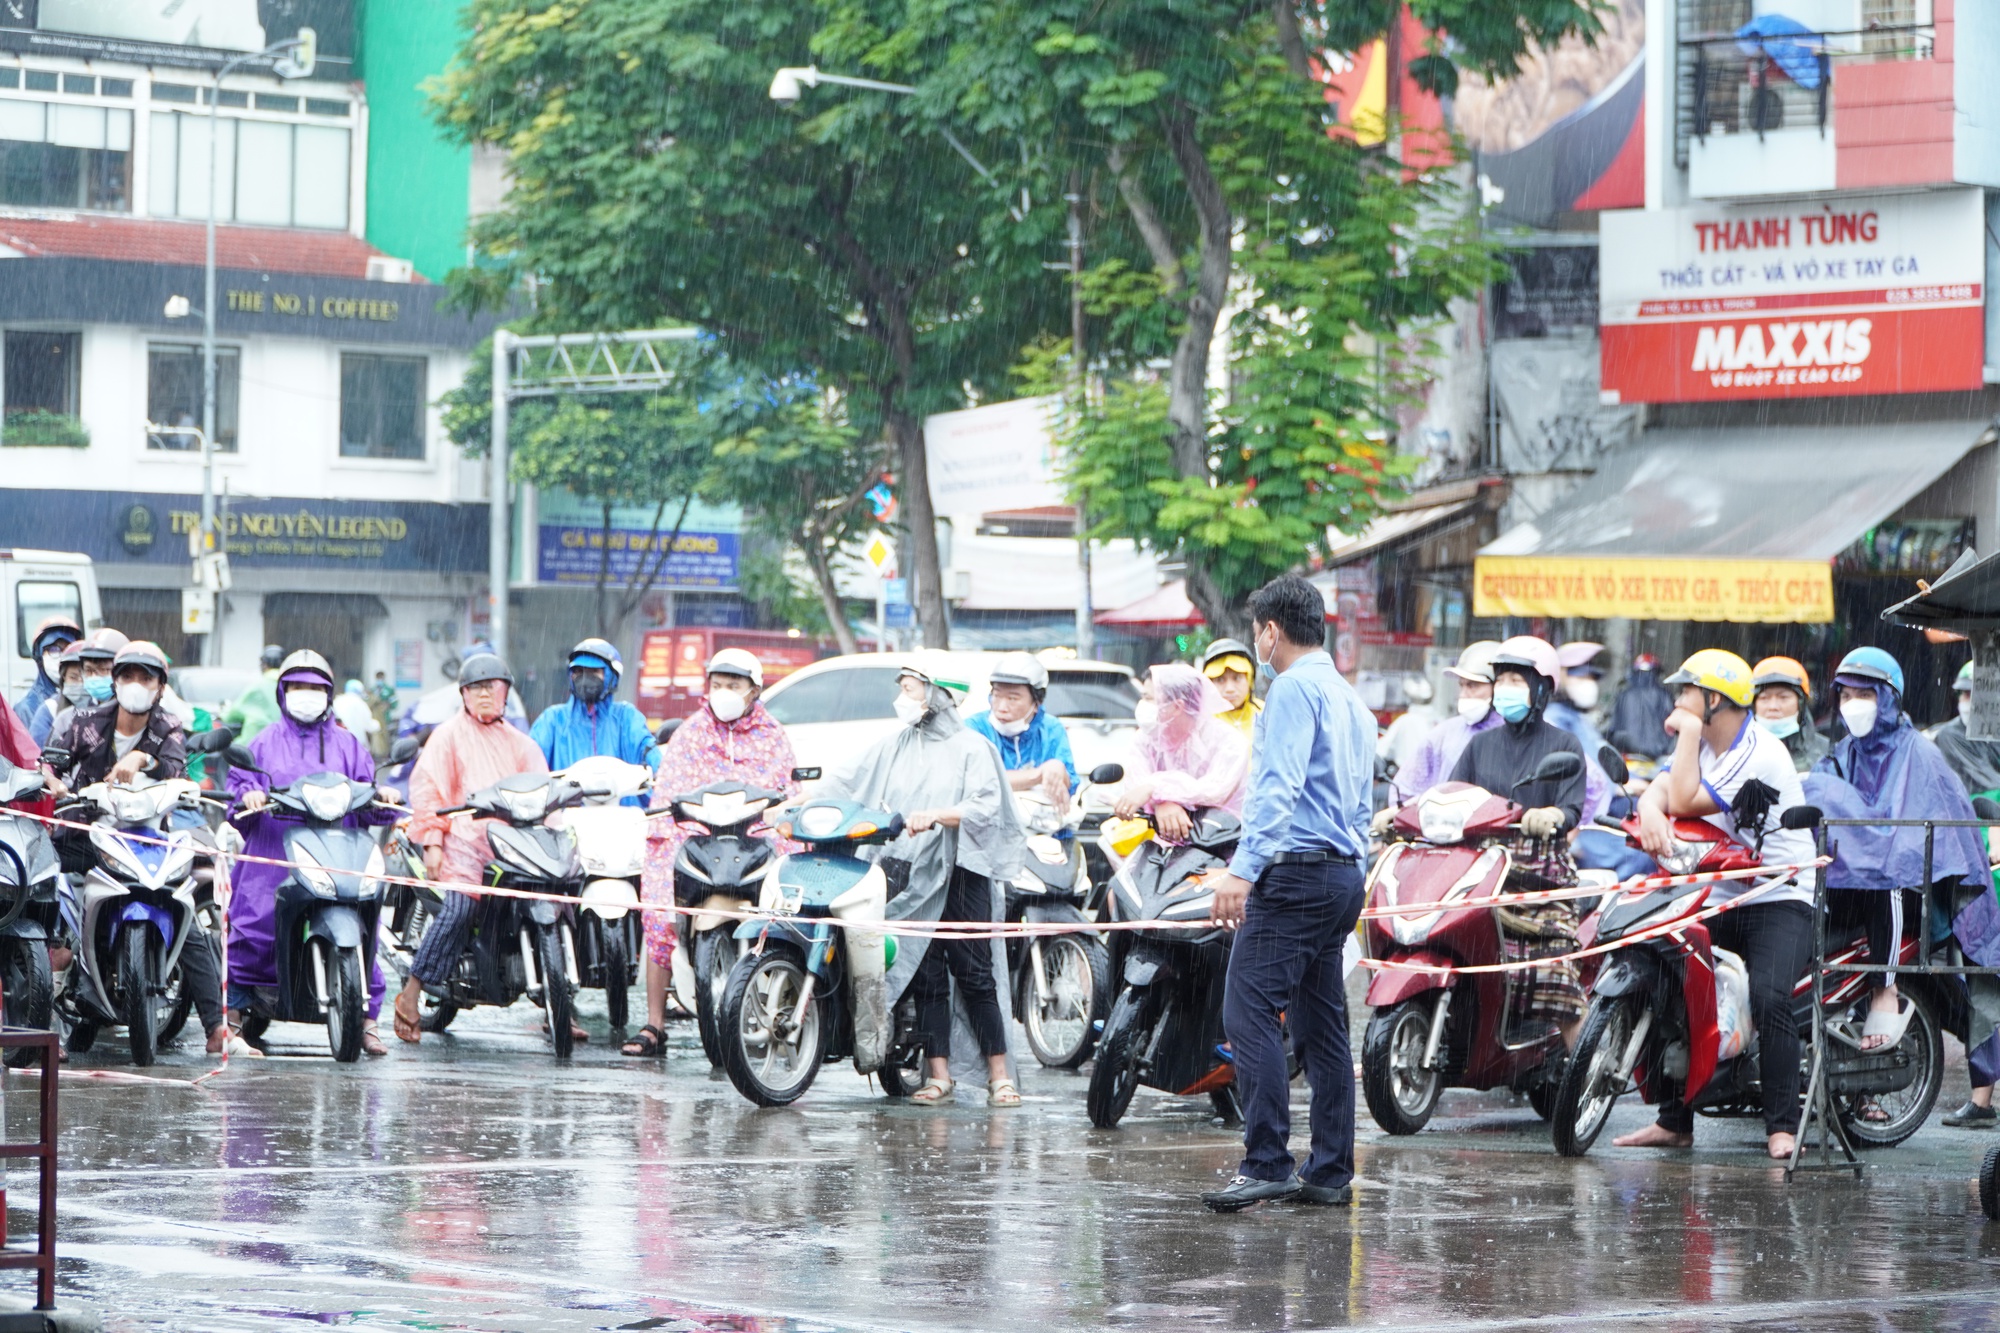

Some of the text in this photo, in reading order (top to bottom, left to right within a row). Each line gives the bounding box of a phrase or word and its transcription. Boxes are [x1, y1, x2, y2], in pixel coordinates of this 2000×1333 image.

[1694, 204, 1879, 252] THANH TÙNG
[1825, 258, 1848, 279] XE
[1854, 256, 1885, 278] TAY
[1892, 255, 1919, 275] GA
[227, 289, 264, 312] THE
[1692, 318, 1872, 371] MAXXIS
[1776, 369, 1798, 385] XE
[1798, 367, 1829, 384] CAO
[242, 509, 324, 539] NGUYÊN
[327, 513, 407, 540] LEGEND
[1621, 575, 1647, 601] XE
[1651, 577, 1687, 602] TAY
[1692, 577, 1720, 602] GA
